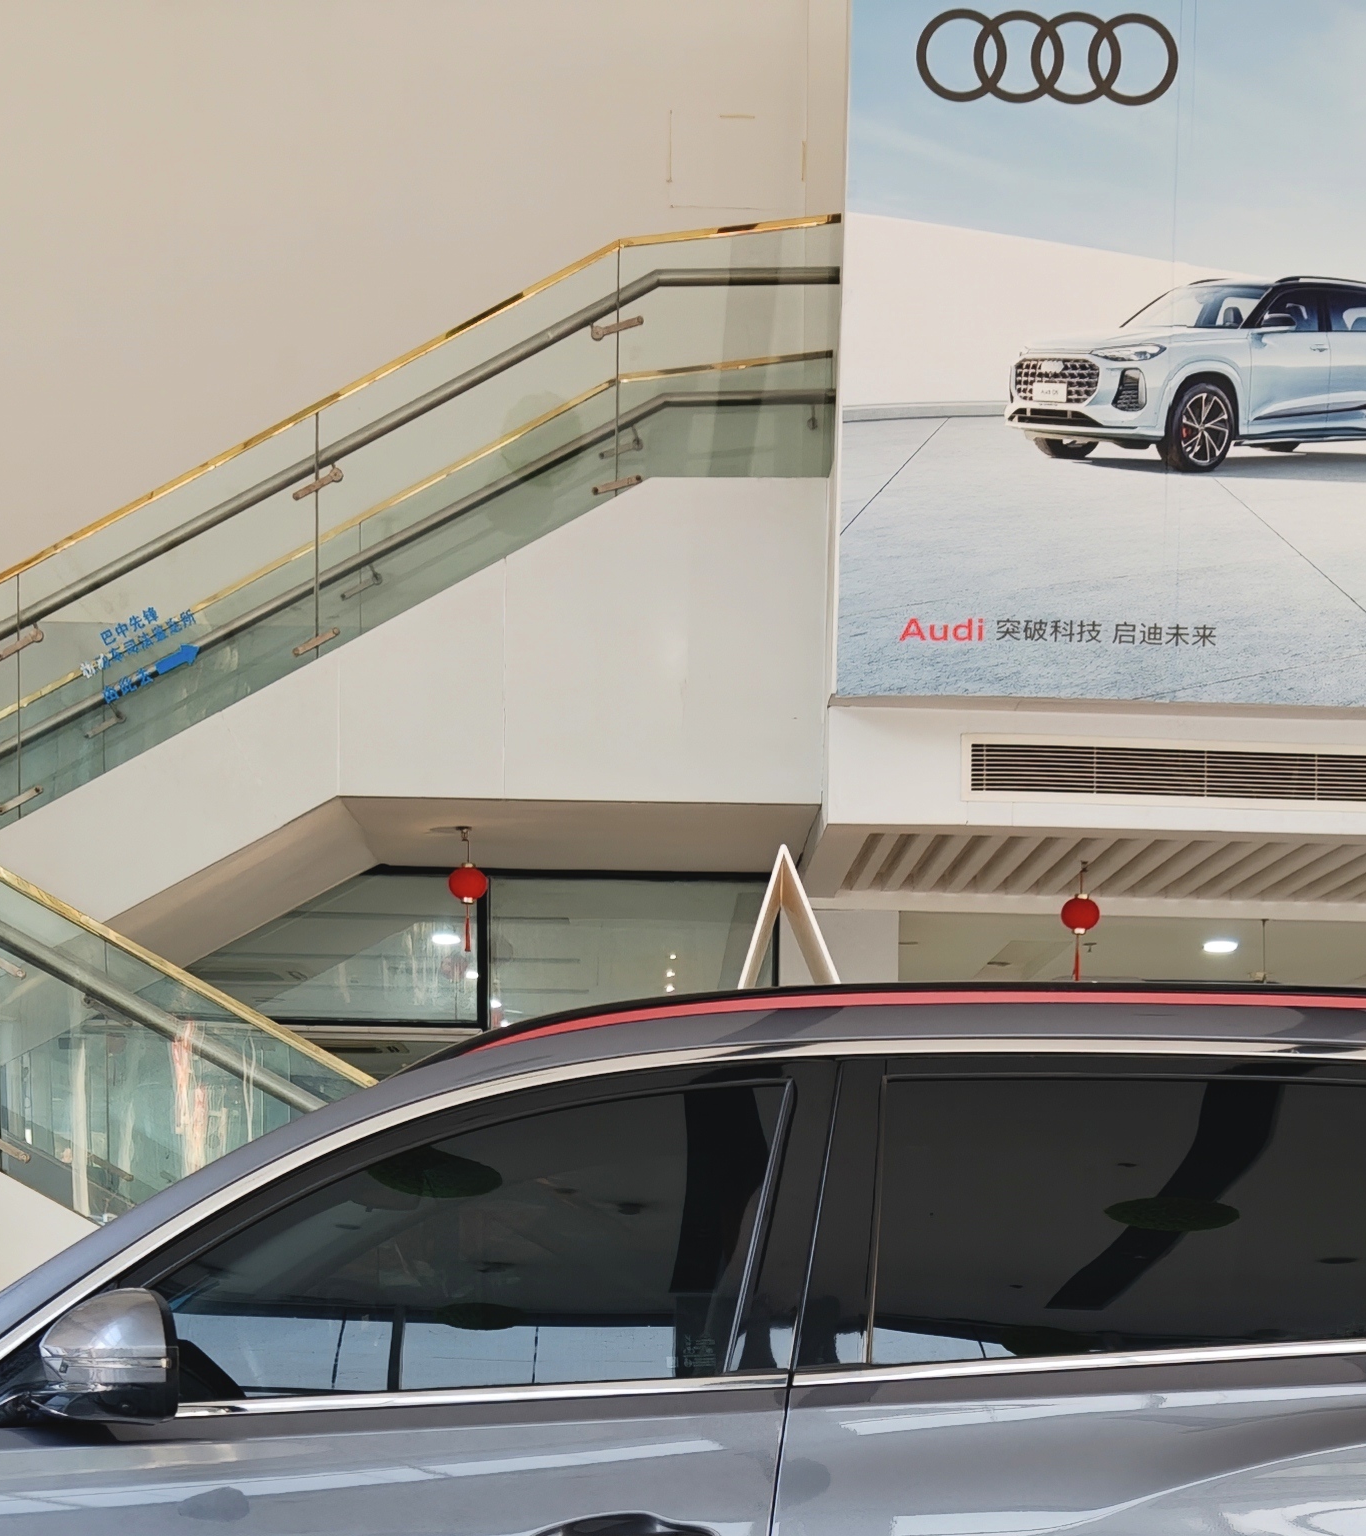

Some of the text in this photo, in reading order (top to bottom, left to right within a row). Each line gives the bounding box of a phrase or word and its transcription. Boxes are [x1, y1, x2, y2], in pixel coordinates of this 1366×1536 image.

[99, 605, 160, 647] 巴中先锋
[899, 617, 1218, 648] Audi 突破科技 启迪未来
